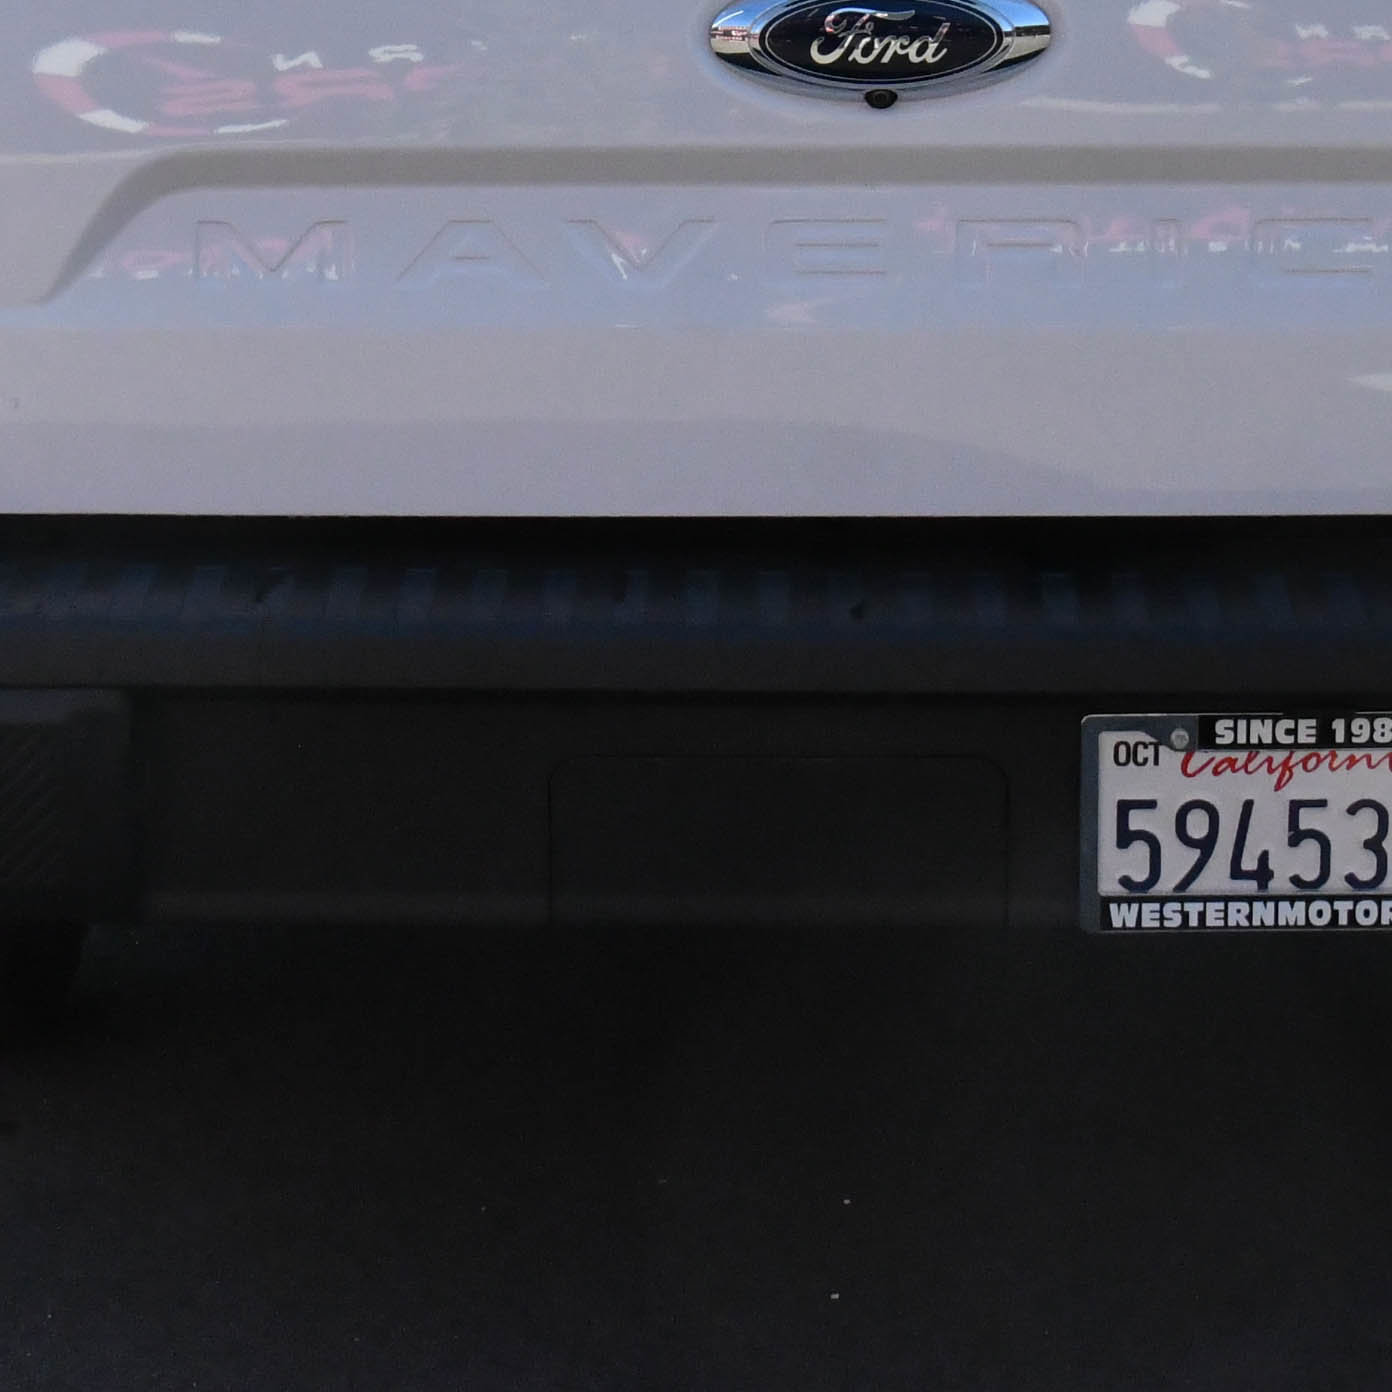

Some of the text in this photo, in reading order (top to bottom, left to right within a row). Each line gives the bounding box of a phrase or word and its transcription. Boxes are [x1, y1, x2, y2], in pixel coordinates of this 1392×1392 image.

[809, 7, 951, 65] Ford
[1214, 718, 1318, 745] SINCE
[1113, 740, 1163, 768] OCT
